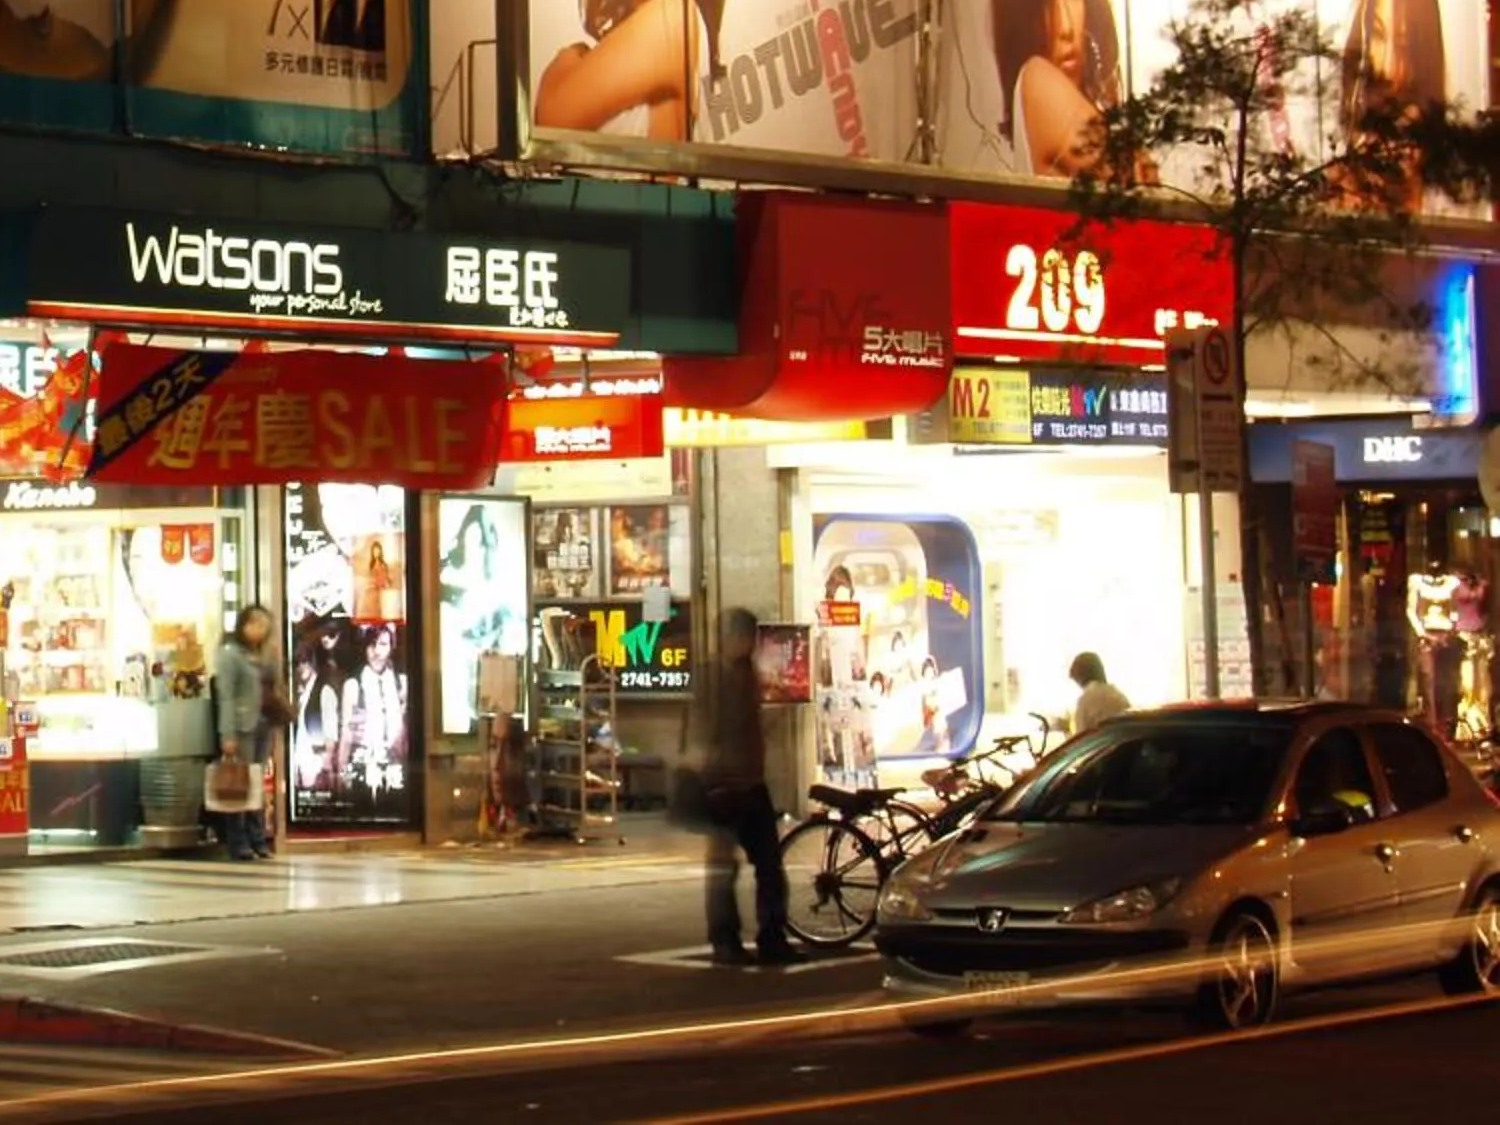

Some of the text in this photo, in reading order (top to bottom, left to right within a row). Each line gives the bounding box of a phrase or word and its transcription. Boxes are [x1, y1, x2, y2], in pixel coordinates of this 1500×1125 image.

[445, 246, 559, 308] 屈臣氏
[1005, 244, 1106, 334] 209
[286, 291, 348, 315] personal
[348, 290, 383, 315] store
[1363, 437, 1422, 462] DHC
[3, 482, 97, 509] Kanebo
[661, 648, 687, 667] 6F
